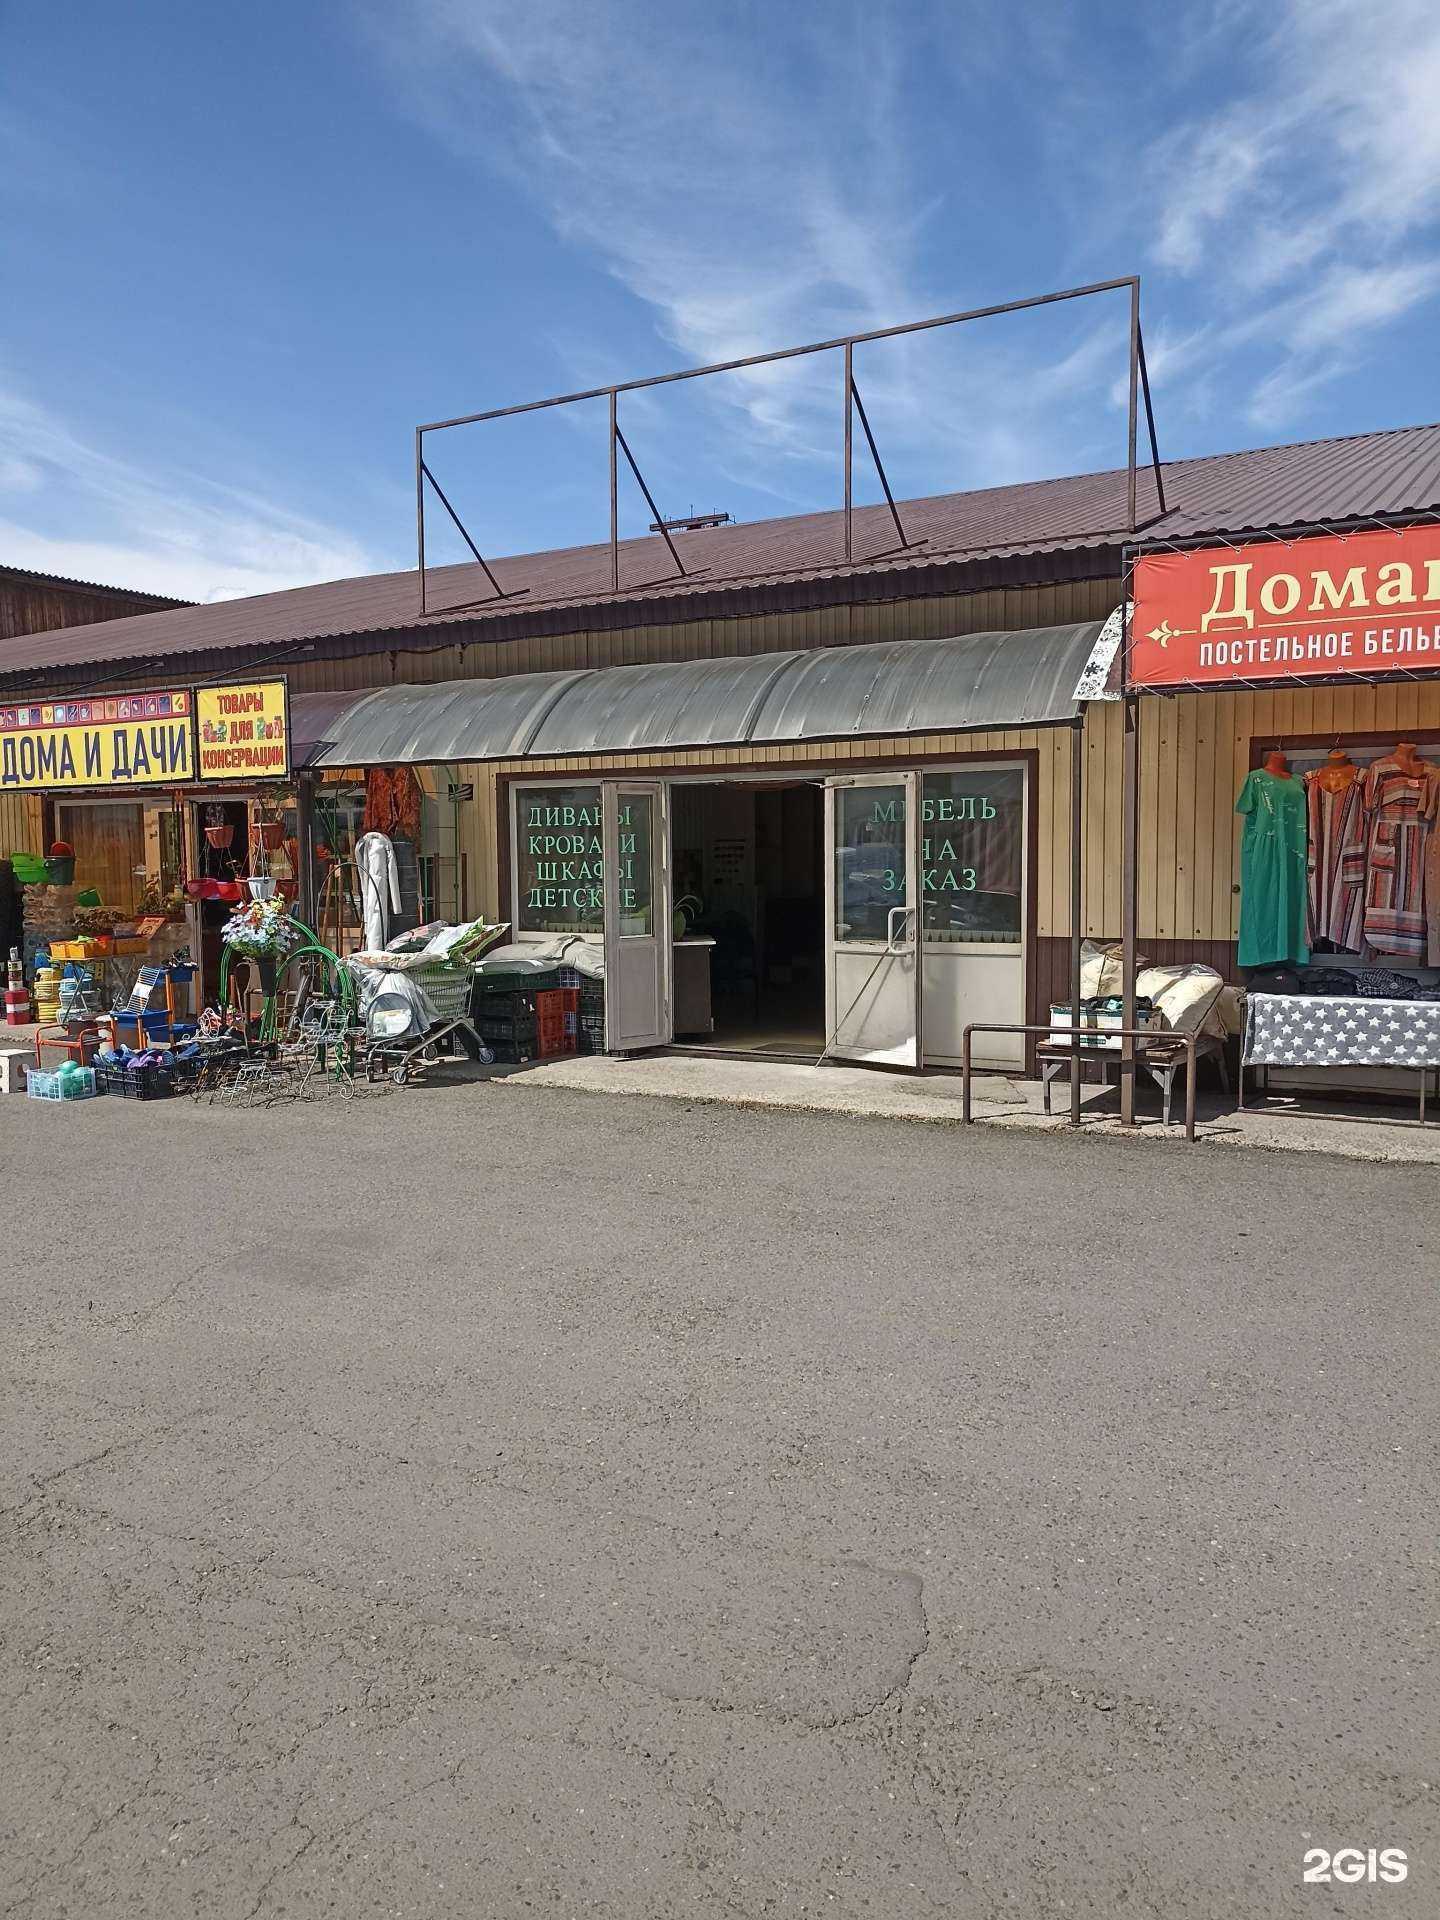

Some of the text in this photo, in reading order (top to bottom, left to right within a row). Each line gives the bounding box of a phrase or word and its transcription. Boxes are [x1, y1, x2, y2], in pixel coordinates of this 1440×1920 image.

[1201, 560, 1440, 633] Дома
[1200, 631, 1353, 666] ПОСТЕЛЬНОЕ
[217, 692, 264, 714] ТОВАРЫ
[229, 720, 254, 744] ДЛЯ
[2, 724, 187, 785] ДОМА И ДАЧИ
[203, 746, 284, 769] КОНСЕРВАЦИИ
[529, 834, 637, 855] КРОВАИ
[527, 888, 637, 907] ДЕТСКЕ
